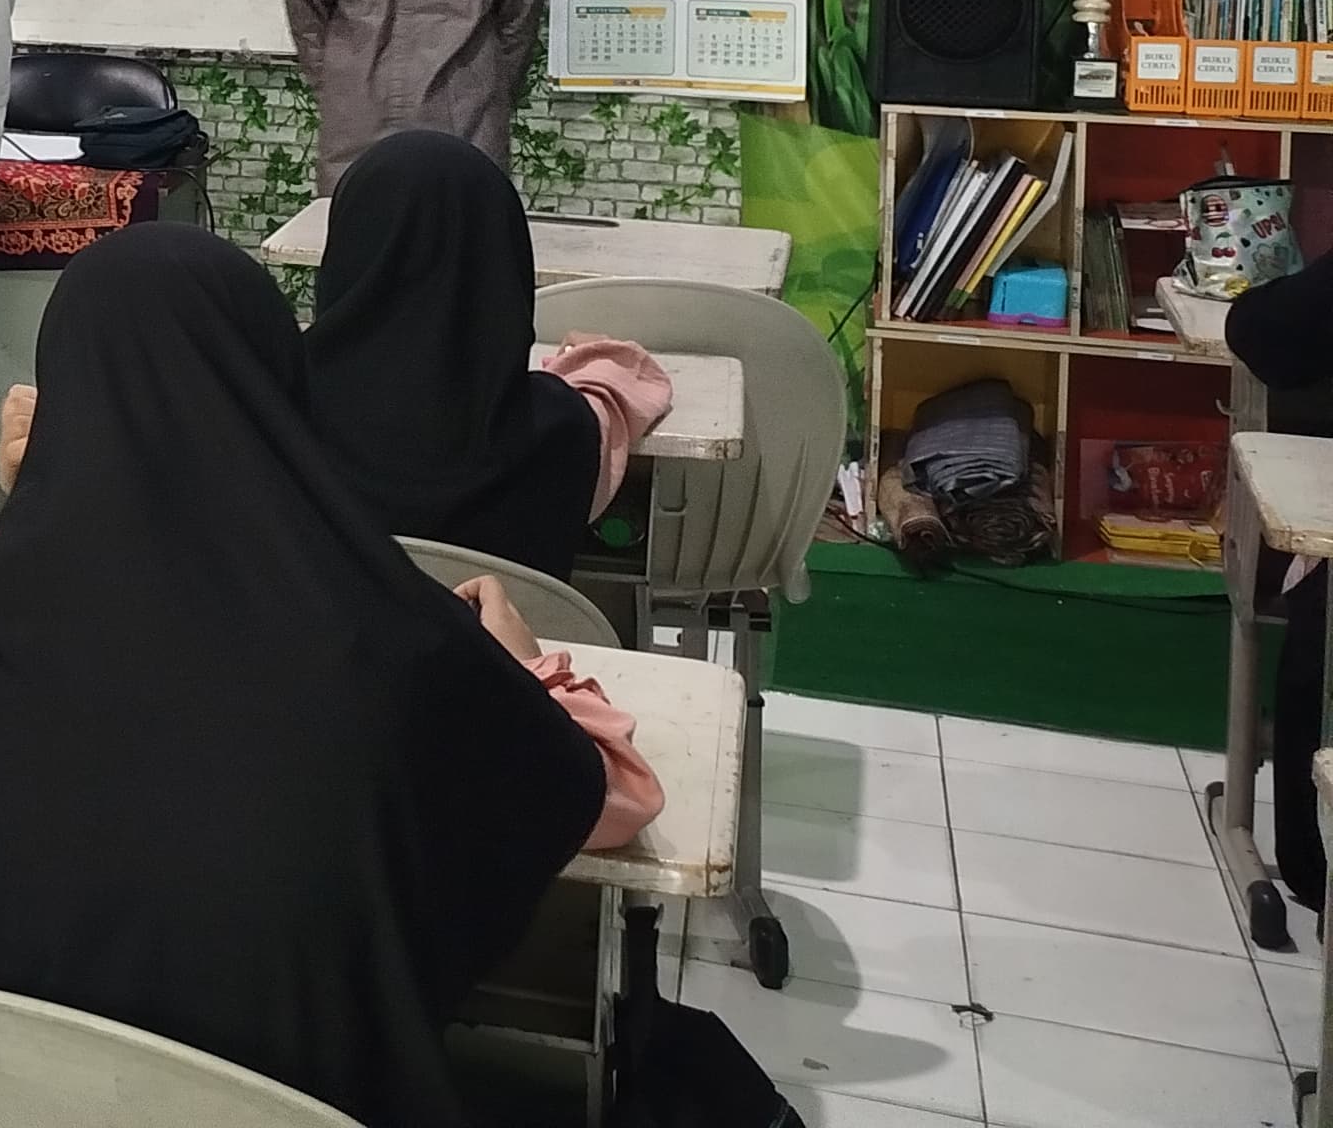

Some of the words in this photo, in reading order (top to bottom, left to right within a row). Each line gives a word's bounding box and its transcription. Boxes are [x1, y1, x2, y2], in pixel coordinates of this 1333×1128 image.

[1144, 53, 1173, 61] BUKU
[1201, 55, 1231, 64] BUKU
[1260, 56, 1290, 64] BUKU
[1141, 61, 1176, 70] CERITA
[1197, 64, 1234, 73] CERITA
[1256, 65, 1294, 74] CERITA
[1252, 212, 1286, 239] UPS!
